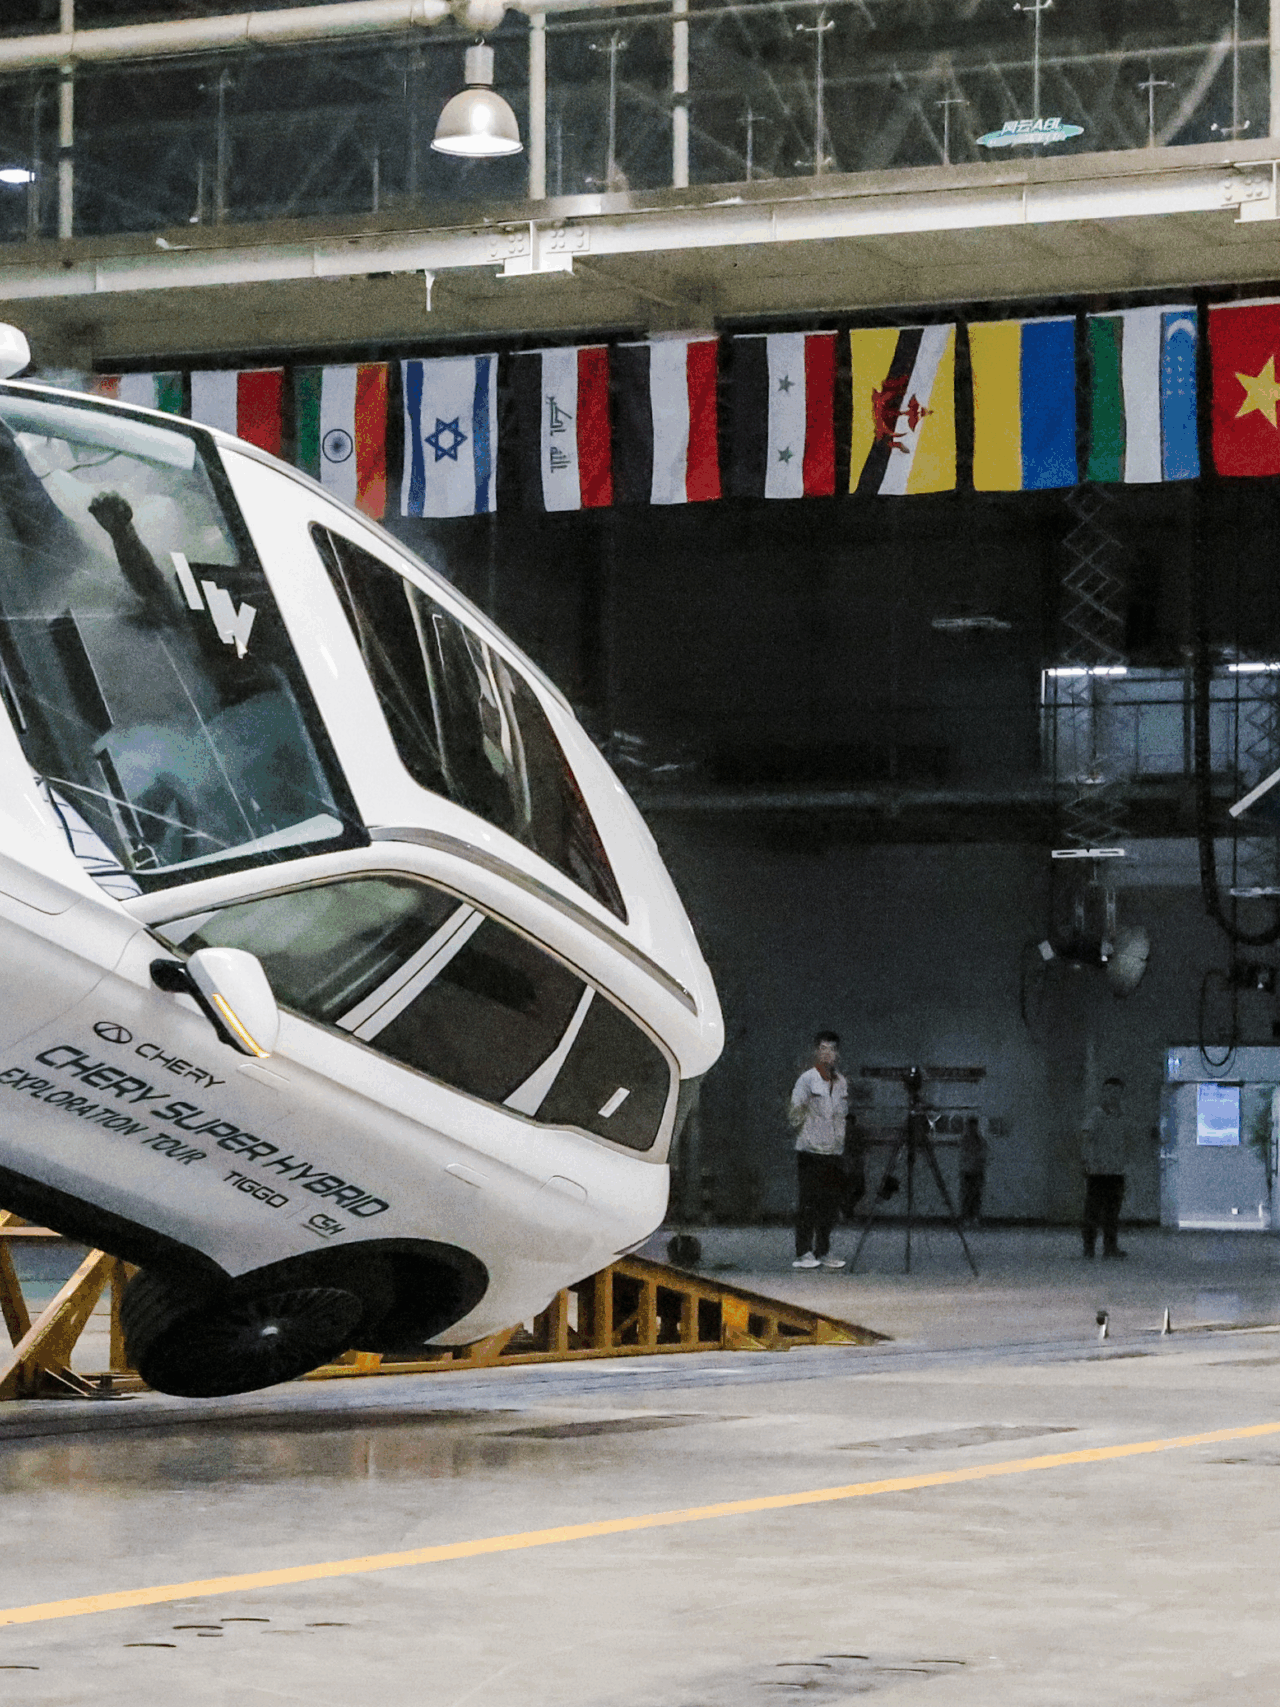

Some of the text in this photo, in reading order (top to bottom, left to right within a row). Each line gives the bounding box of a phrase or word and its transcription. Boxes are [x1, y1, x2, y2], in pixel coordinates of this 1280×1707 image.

[134, 1043, 226, 1088] CHERY
[34, 1045, 390, 1218] CHERY SUPER HYBRID
[141, 1132, 208, 1165] TOUR
[223, 1170, 347, 1235] TIGGO CSH
